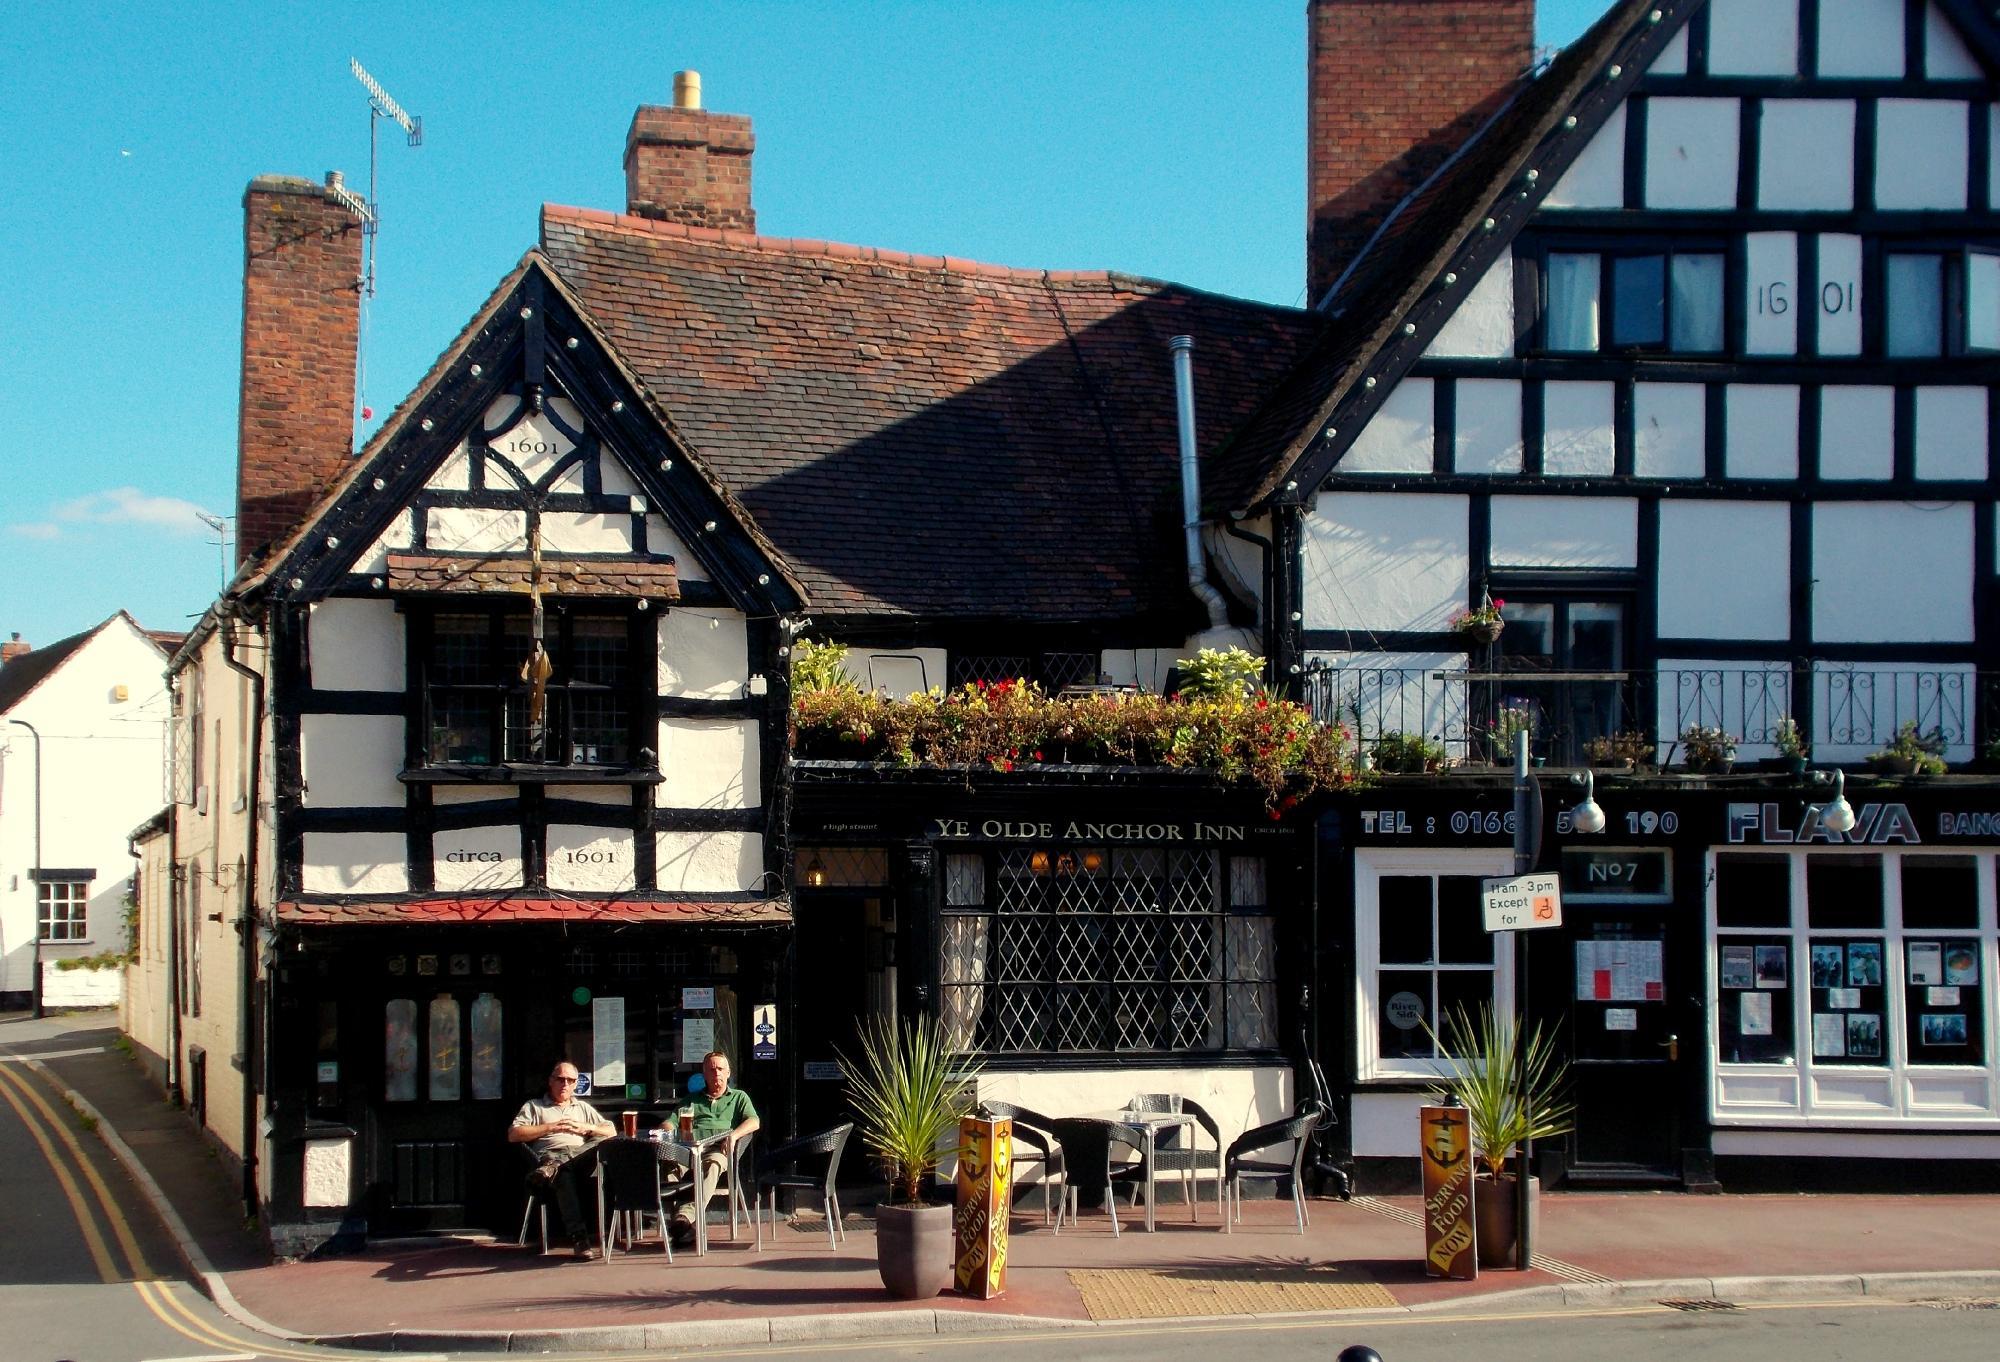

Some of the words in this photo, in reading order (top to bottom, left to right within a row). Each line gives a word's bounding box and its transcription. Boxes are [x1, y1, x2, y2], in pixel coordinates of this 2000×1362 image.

[510, 437, 558, 455] 1601
[935, 819, 970, 837] YE
[981, 820, 1053, 838] OLDE
[1063, 821, 1184, 840] ANCHOR
[1193, 822, 1245, 841] INN
[1360, 811, 1412, 834] TEL
[1625, 811, 1679, 834] 190
[1728, 803, 1921, 843] FLAVA
[446, 848, 504, 863] circa
[567, 848, 615, 864] 1601
[1489, 896, 1529, 909] Except
[1501, 914, 1518, 925] for
[1425, 1159, 1471, 1217] SERVING
[956, 1176, 990, 1229] SERVING
[1432, 1193, 1469, 1236] FOOD
[960, 1209, 987, 1251] FOOD
[1436, 1226, 1470, 1262] NOW
[961, 1246, 984, 1277] NOW
